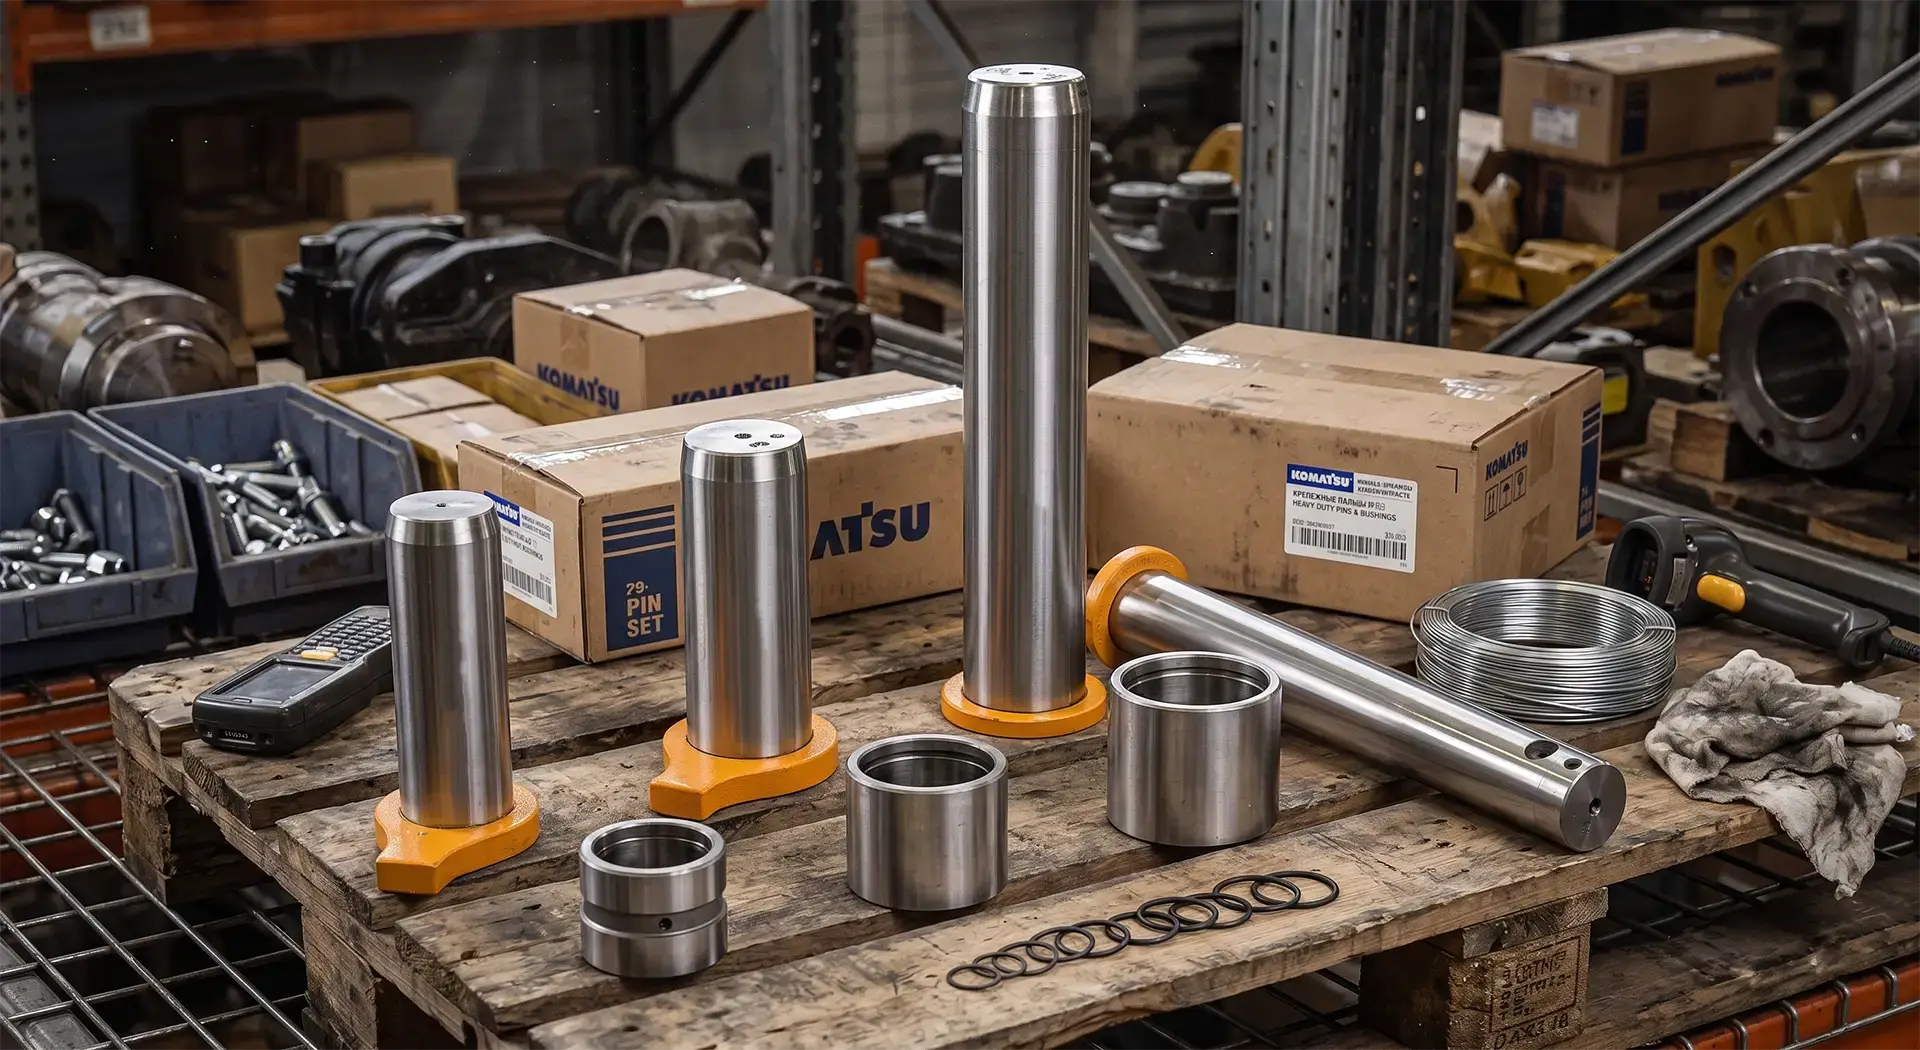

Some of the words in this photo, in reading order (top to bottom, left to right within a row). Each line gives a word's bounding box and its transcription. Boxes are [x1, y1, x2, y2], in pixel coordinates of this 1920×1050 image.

[537, 362, 620, 411] KOMATSU
[1485, 440, 1528, 481] KOMATSU
[1291, 469, 1351, 488] KOMATSU
[1293, 500, 1315, 509] HEAVY
[1316, 503, 1335, 512] DUTY
[1336, 506, 1352, 515] PINS
[1360, 510, 1397, 521] BUSHINGS
[810, 501, 931, 561] ATSU
[627, 593, 661, 617] PIN
[627, 613, 664, 638] SET
